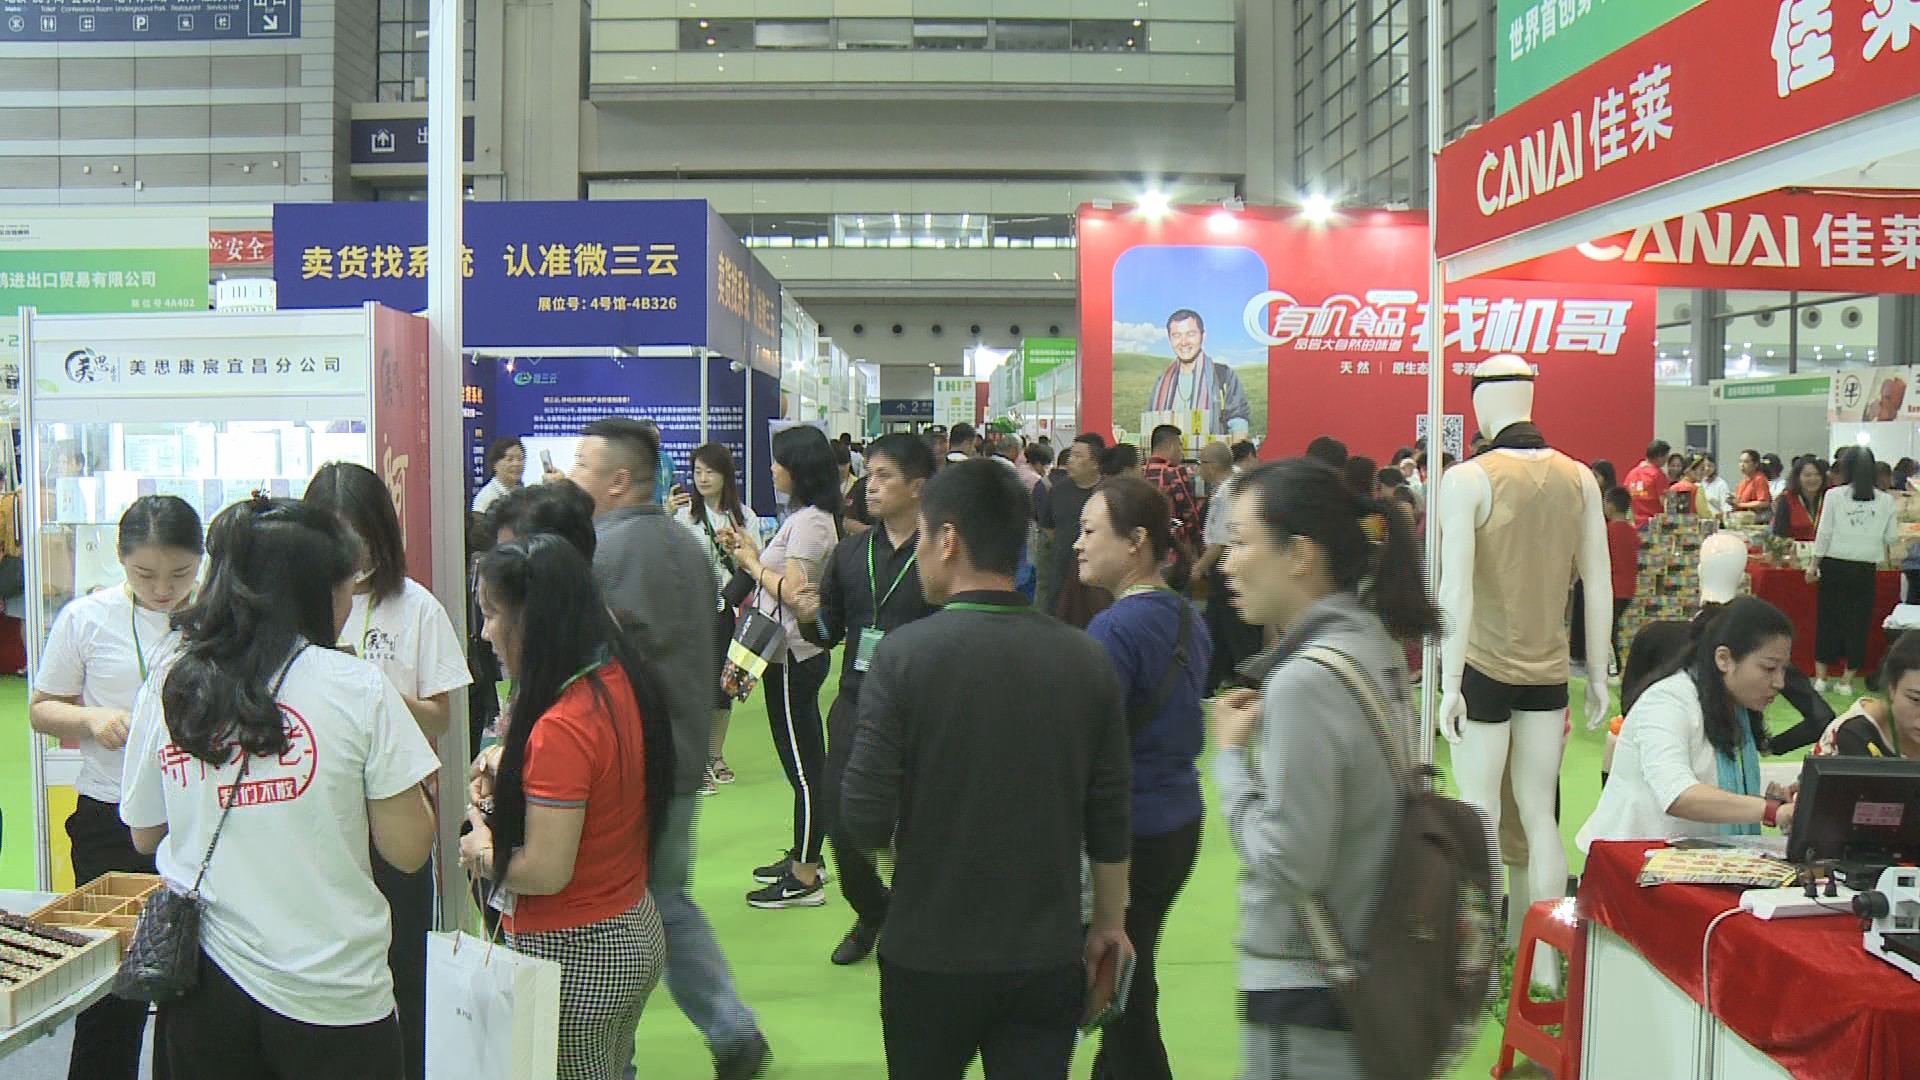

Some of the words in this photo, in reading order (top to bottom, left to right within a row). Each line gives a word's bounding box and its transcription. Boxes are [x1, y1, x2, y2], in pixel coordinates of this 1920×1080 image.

[1477, 110, 1583, 216] CANAI
[1589, 63, 1673, 172] 佳莱
[503, 243, 680, 279] 认准微三云
[1411, 296, 1633, 356] 找机哥
[129, 356, 341, 376] 美思康宸宜昌分公司
[1340, 361, 1370, 375] 天然
